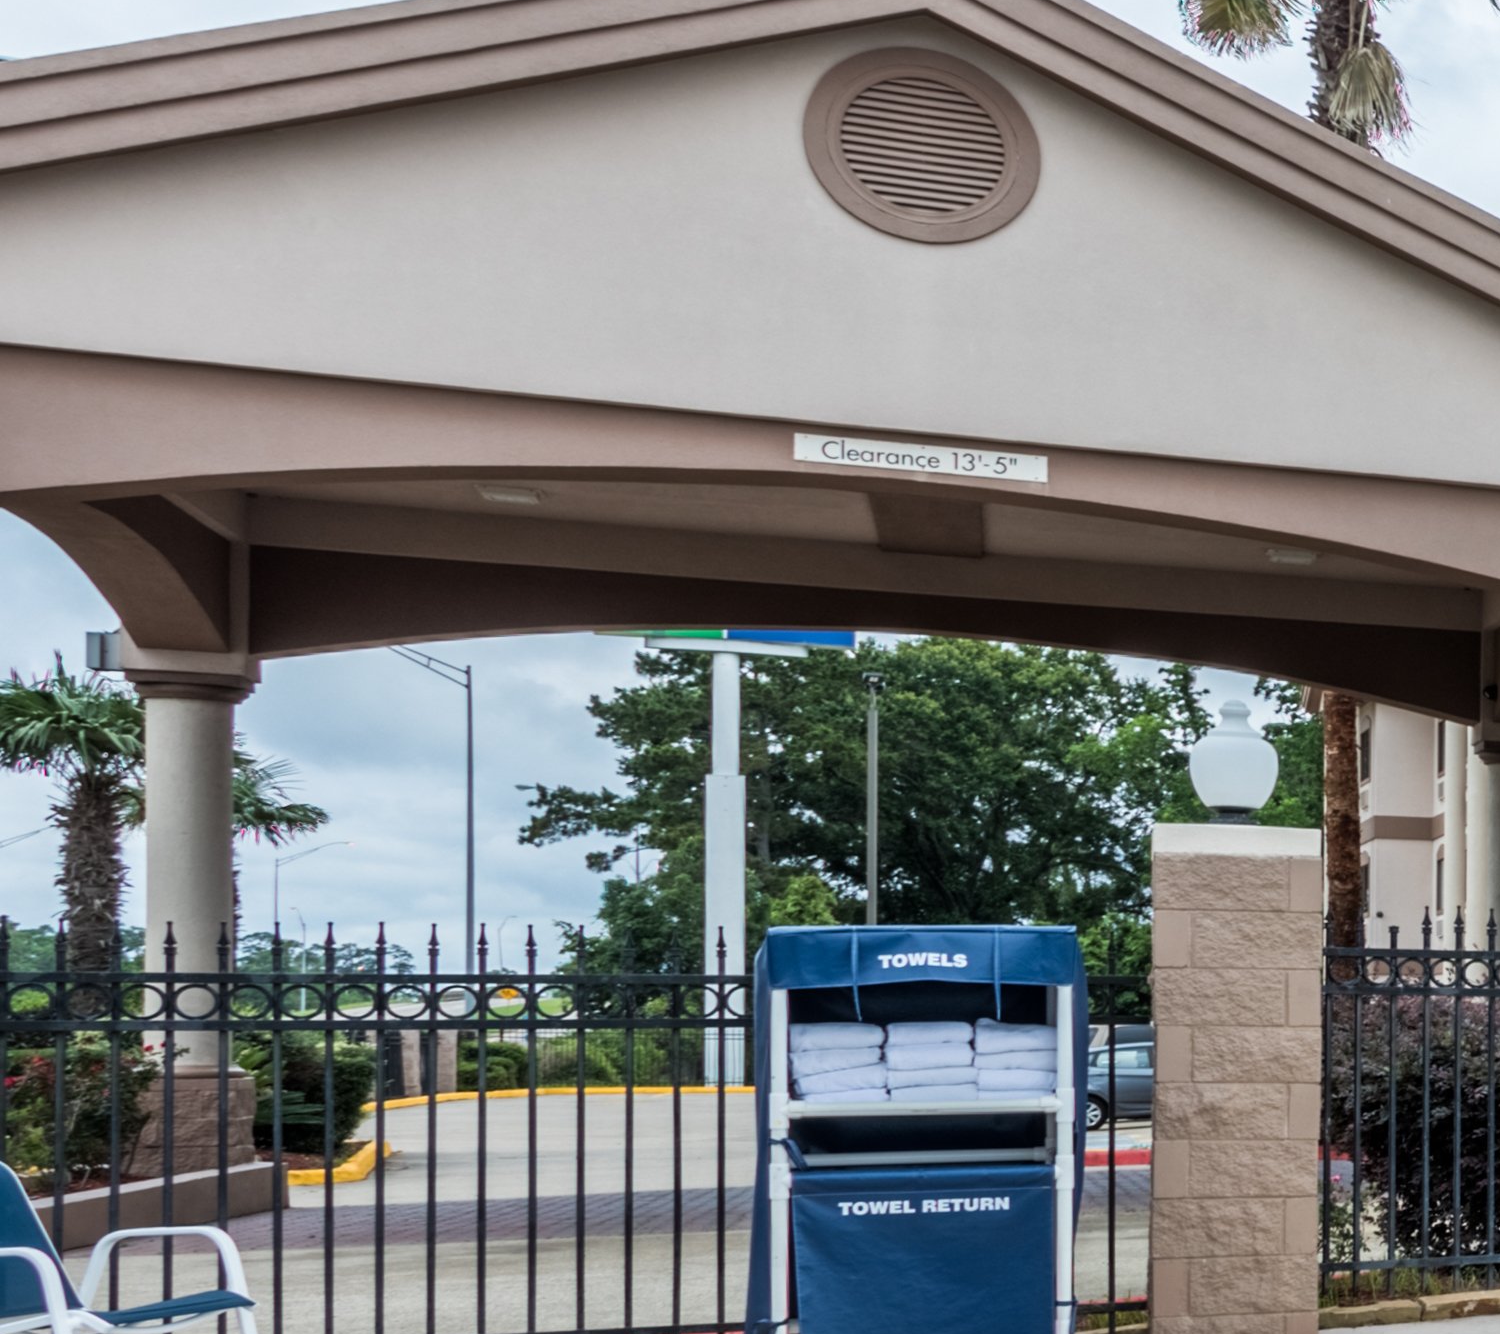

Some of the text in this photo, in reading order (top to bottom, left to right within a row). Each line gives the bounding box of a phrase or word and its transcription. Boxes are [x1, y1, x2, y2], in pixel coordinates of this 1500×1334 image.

[822, 440, 940, 469] Clearance
[877, 952, 968, 969] TOWELS
[838, 1197, 1010, 1216] TOWEL RETURN
